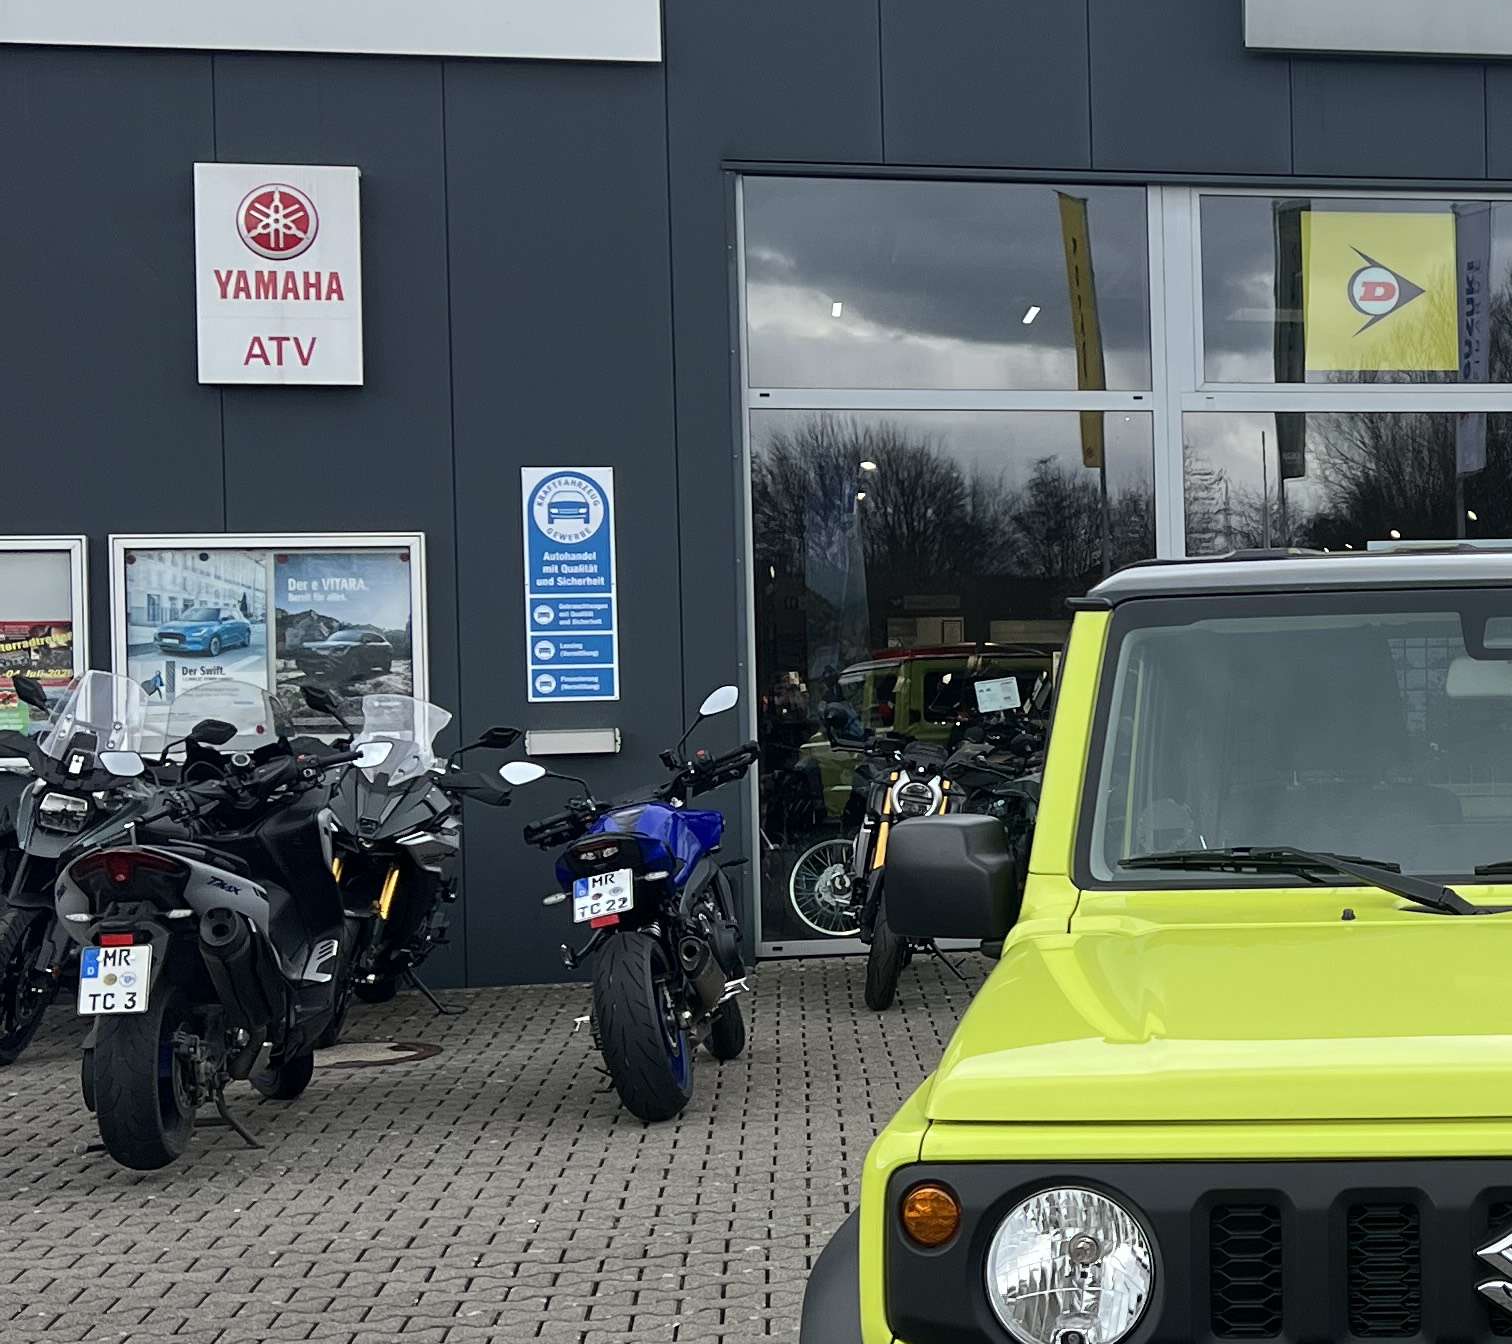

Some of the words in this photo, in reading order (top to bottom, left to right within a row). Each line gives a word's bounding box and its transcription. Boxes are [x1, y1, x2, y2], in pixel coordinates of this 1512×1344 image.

[213, 269, 345, 301] YAMAHA
[243, 335, 317, 366] ATV
[543, 552, 597, 561] Autohandel
[542, 564, 558, 574] mit
[288, 578, 308, 591] Der
[536, 577, 554, 586] und
[556, 576, 605, 586] Sicherheit
[182, 666, 197, 676] Der
[592, 873, 615, 888] MR
[577, 902, 601, 918] TC
[103, 948, 131, 967] MR
[88, 993, 115, 1011] TC
[124, 991, 137, 1010] 3
